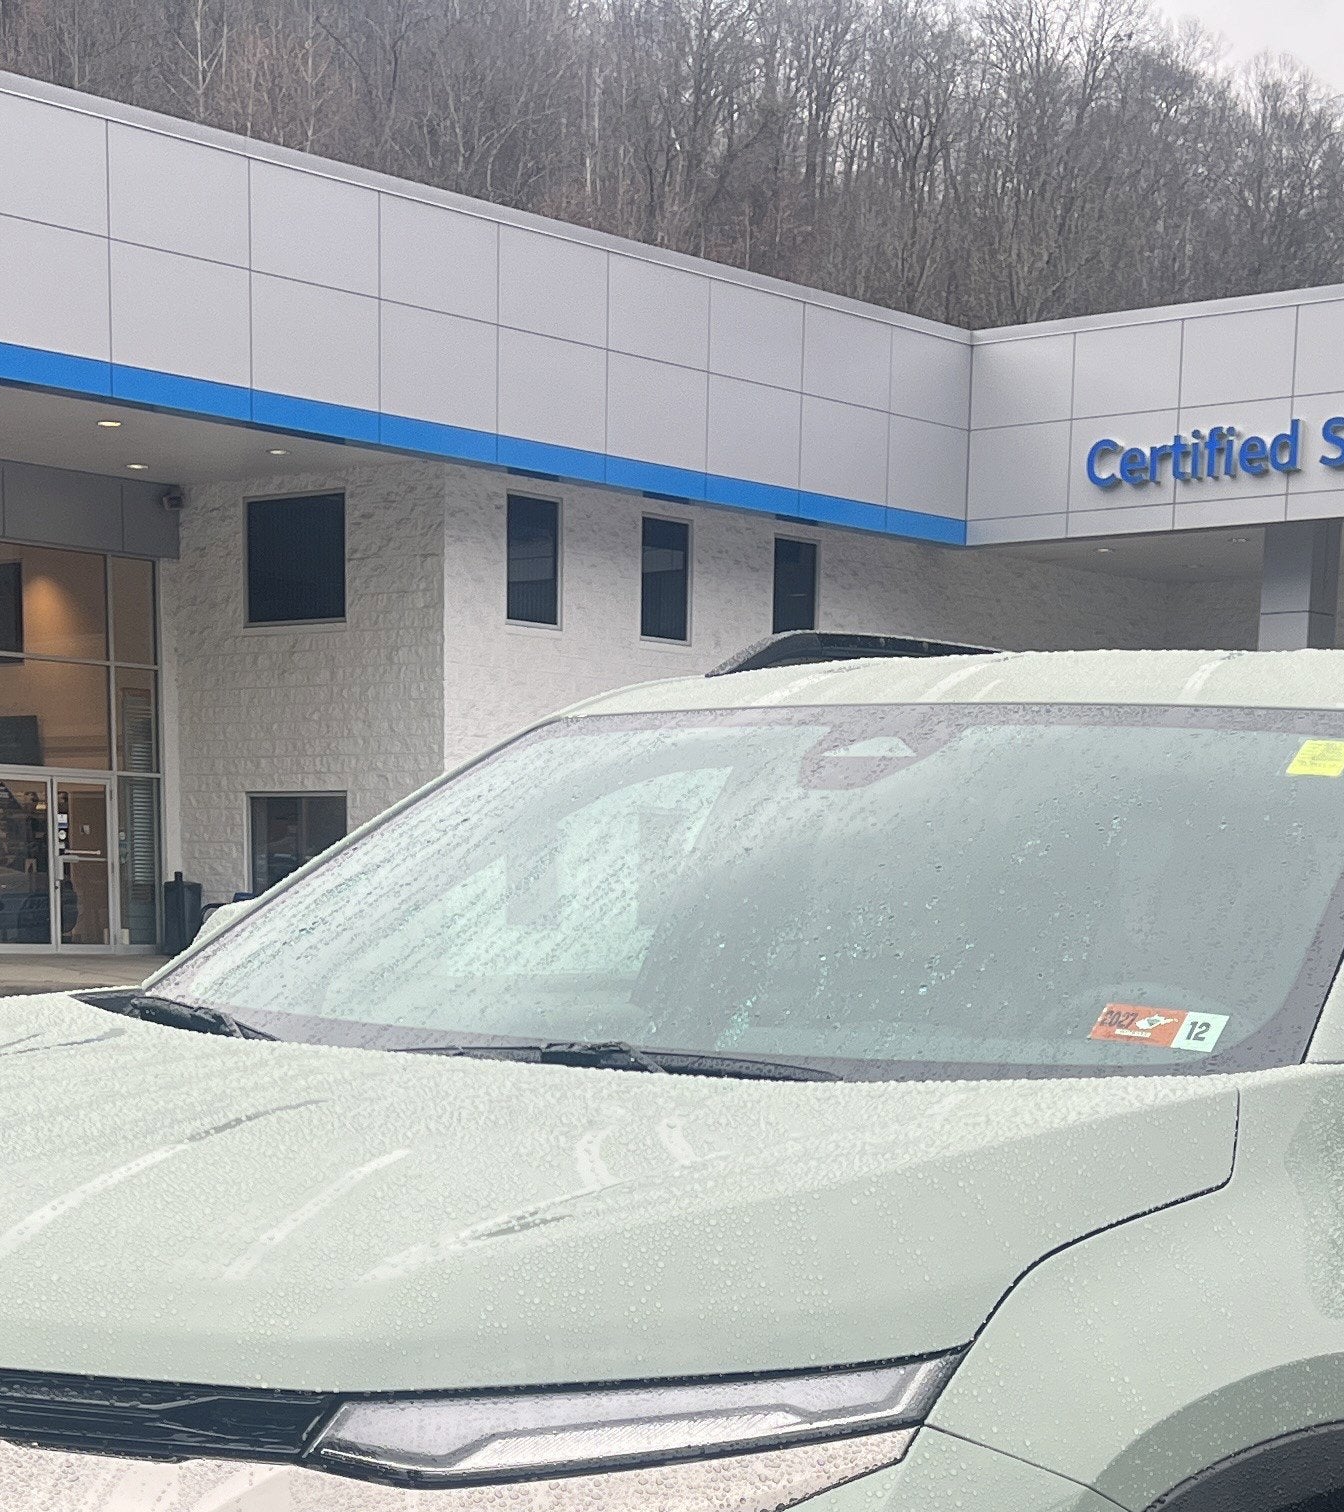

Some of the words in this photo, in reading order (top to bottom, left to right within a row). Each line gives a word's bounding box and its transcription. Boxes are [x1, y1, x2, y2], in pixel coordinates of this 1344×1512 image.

[1085, 418, 1301, 488] Certified
[1100, 1009, 1138, 1029] 2027
[1185, 1020, 1212, 1042] 12
